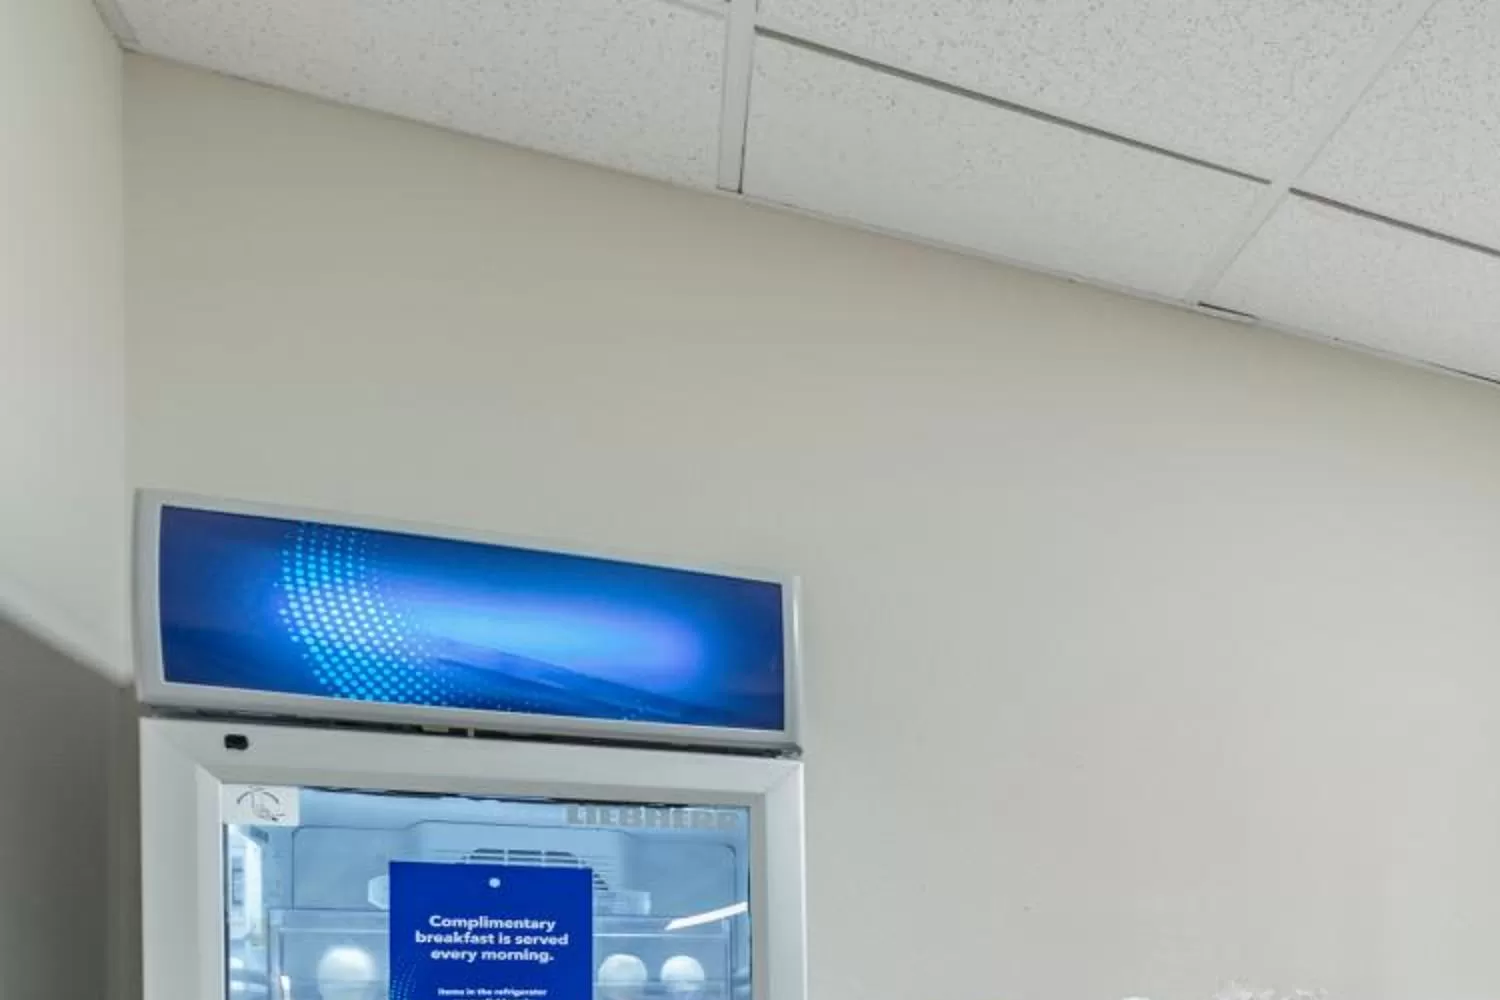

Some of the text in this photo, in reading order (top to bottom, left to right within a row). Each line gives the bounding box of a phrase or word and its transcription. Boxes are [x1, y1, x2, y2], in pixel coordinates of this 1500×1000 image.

[429, 915, 556, 933] Complimentary
[415, 930, 569, 945] breakfast is served
[430, 948, 554, 964] every morning.
